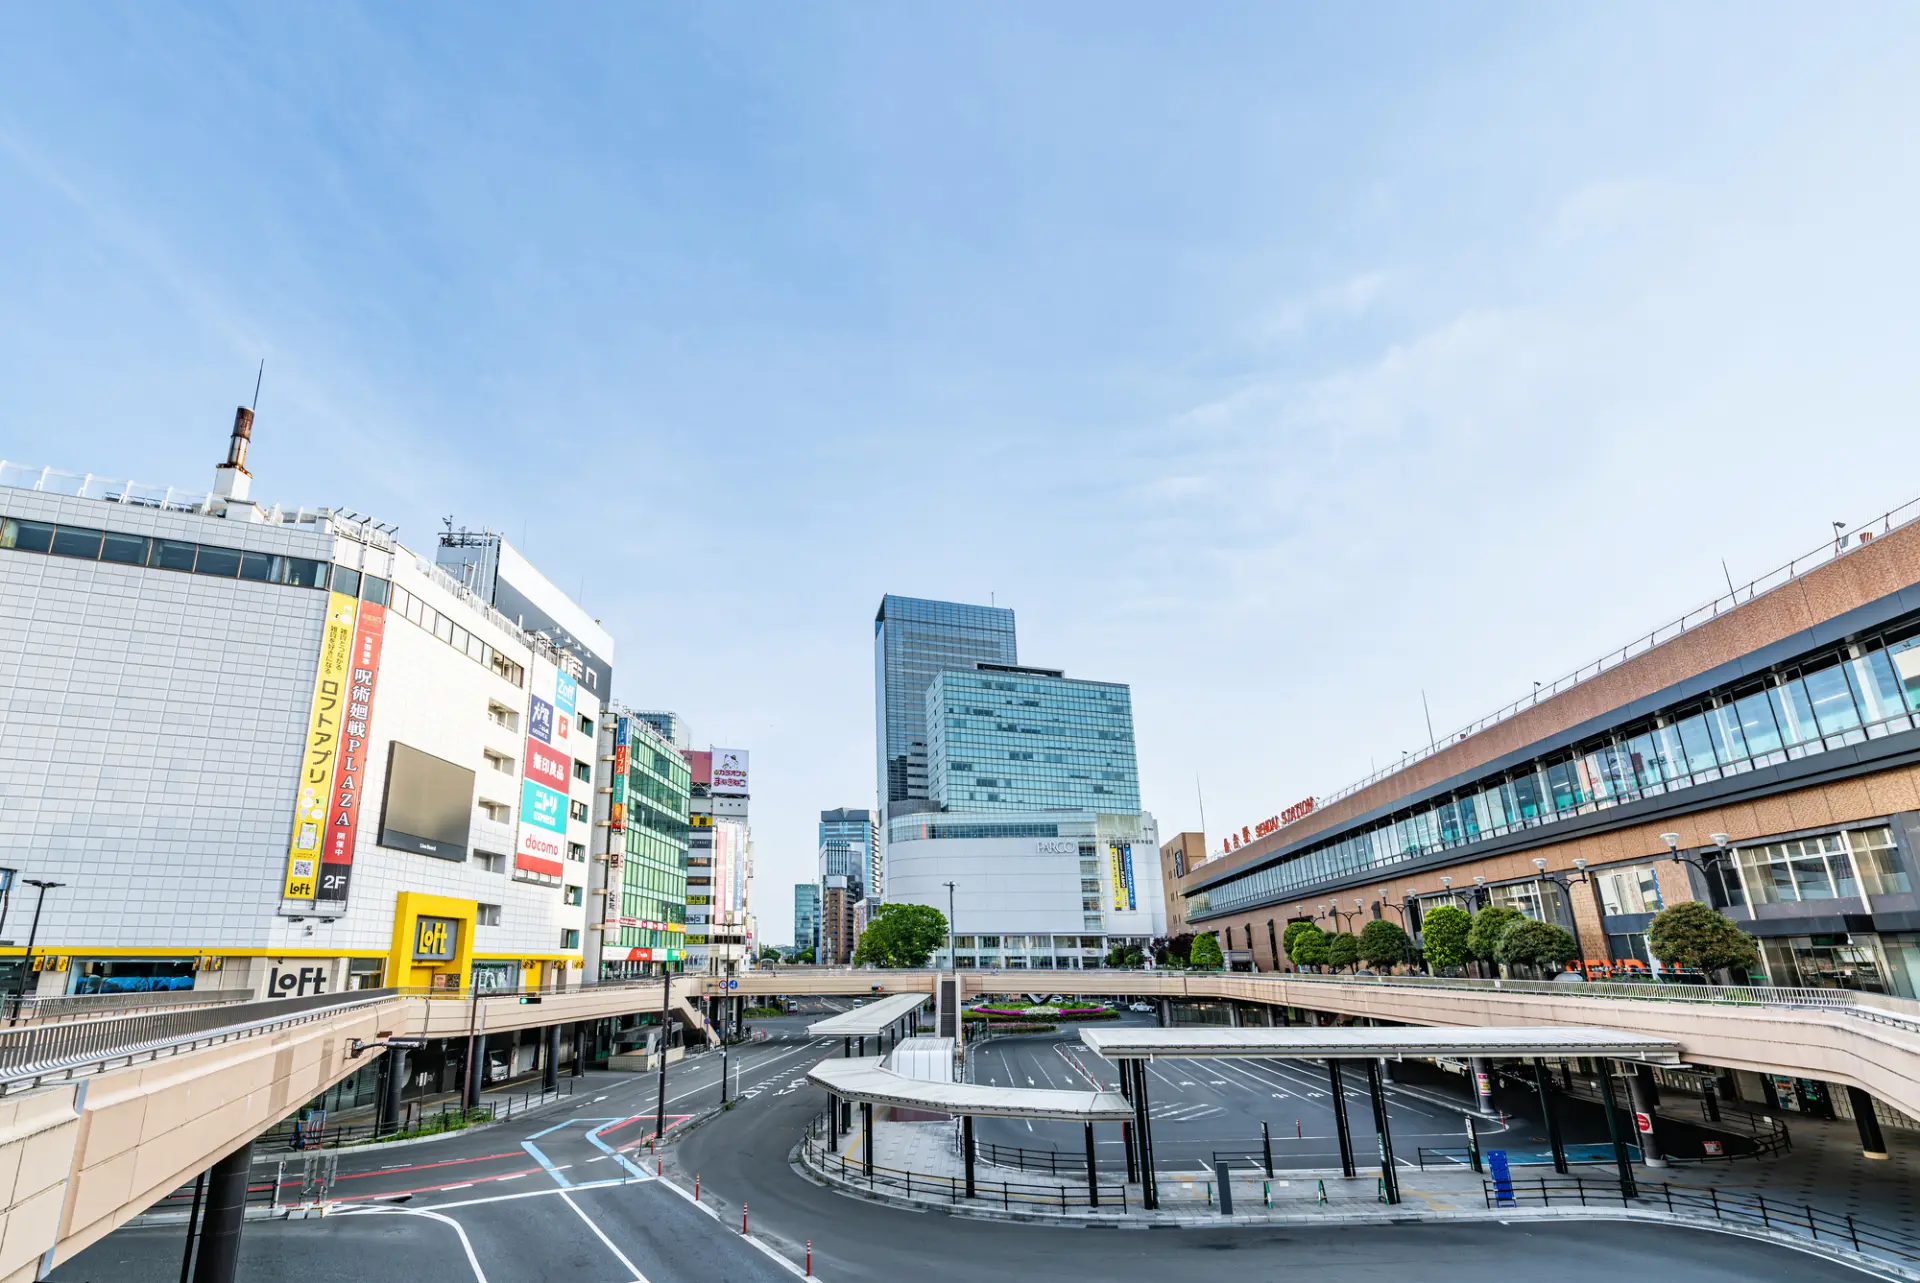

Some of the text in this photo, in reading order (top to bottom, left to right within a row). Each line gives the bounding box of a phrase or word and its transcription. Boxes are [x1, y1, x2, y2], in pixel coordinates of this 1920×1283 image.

[557, 678, 575, 699] Zoff
[310, 680, 339, 784] ロフトアプリ
[533, 752, 564, 781] 無印良品
[535, 790, 558, 815] ニトリ
[1255, 796, 1314, 839] SENDAI STATION
[334, 832, 346, 856] 開催中
[525, 834, 559, 856] docomo
[1036, 840, 1076, 854] PARCO
[323, 874, 347, 889] 2F
